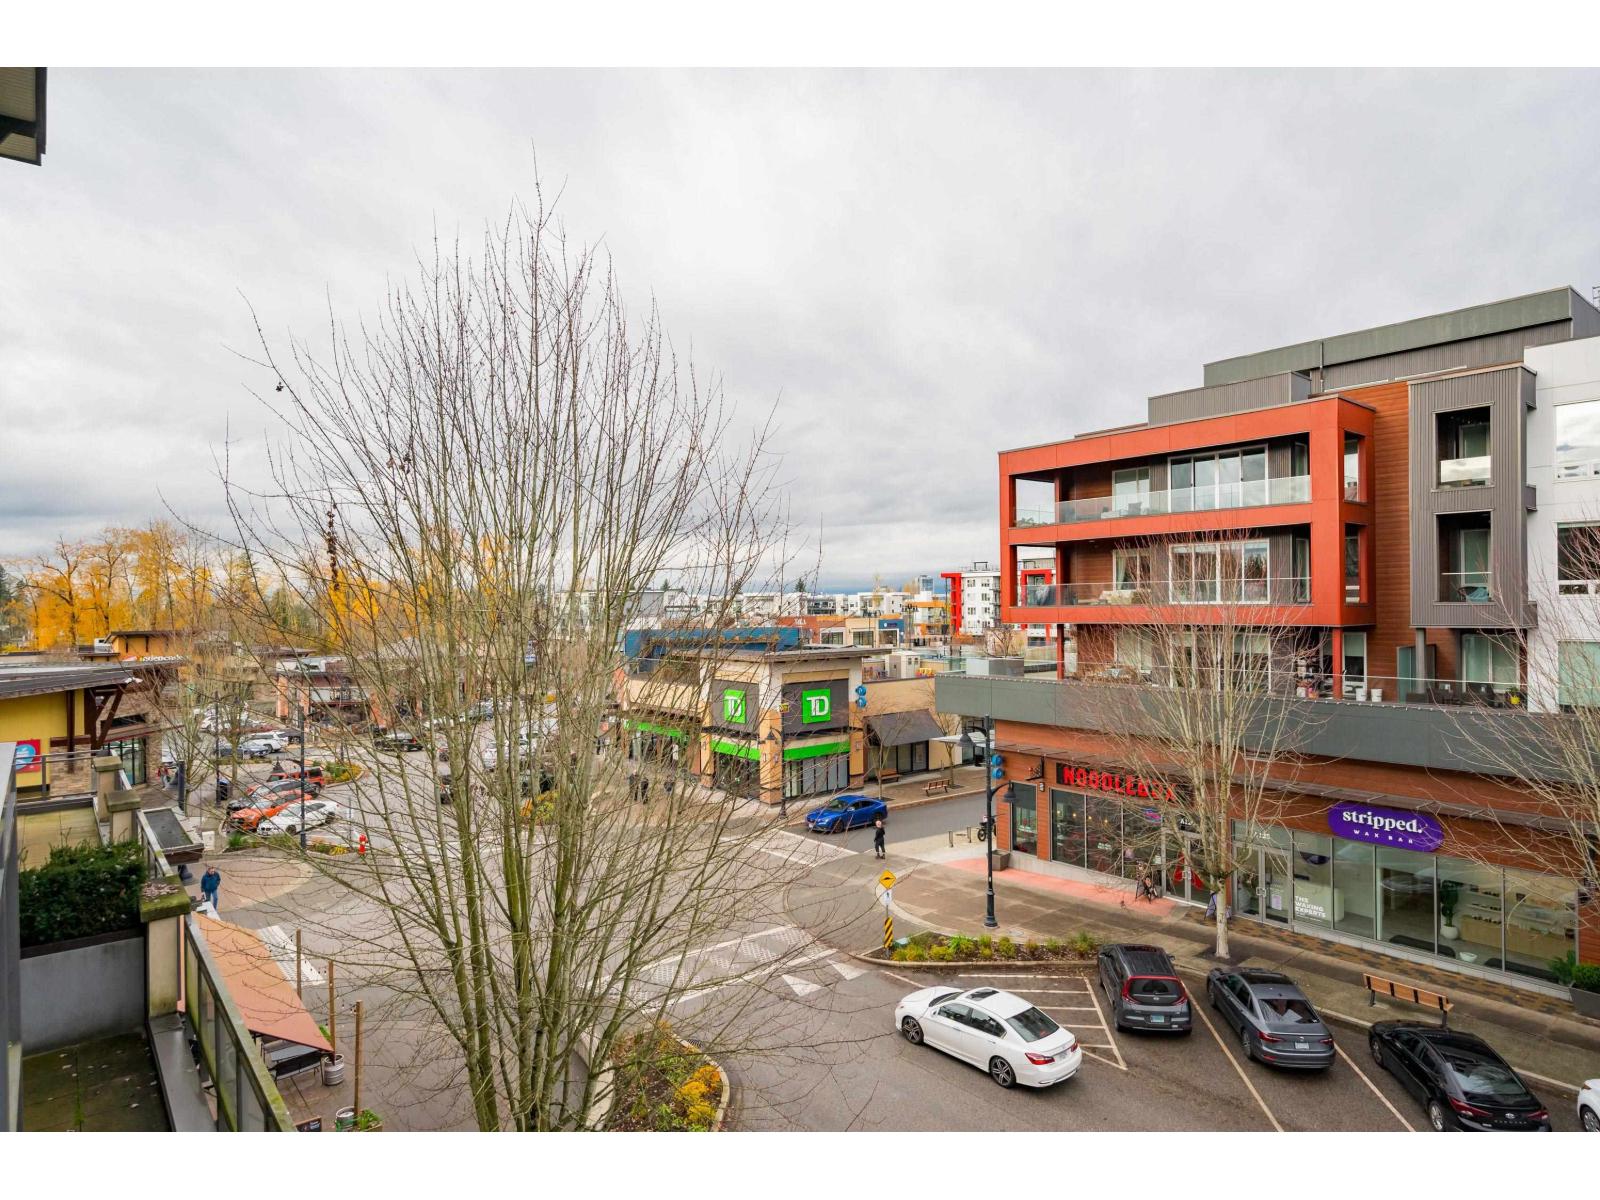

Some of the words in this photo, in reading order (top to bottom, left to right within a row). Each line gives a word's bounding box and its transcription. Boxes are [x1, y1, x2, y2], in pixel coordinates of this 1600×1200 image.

[724, 695, 742, 717] TD
[806, 695, 829, 717] TD
[1342, 811, 1422, 834] stripped.
[1353, 829, 1379, 839] WAX
[1388, 835, 1413, 844] BAR
[1294, 895, 1309, 904] THE
[1294, 901, 1324, 912] WAXING
[1295, 906, 1326, 918] EXPERTS
